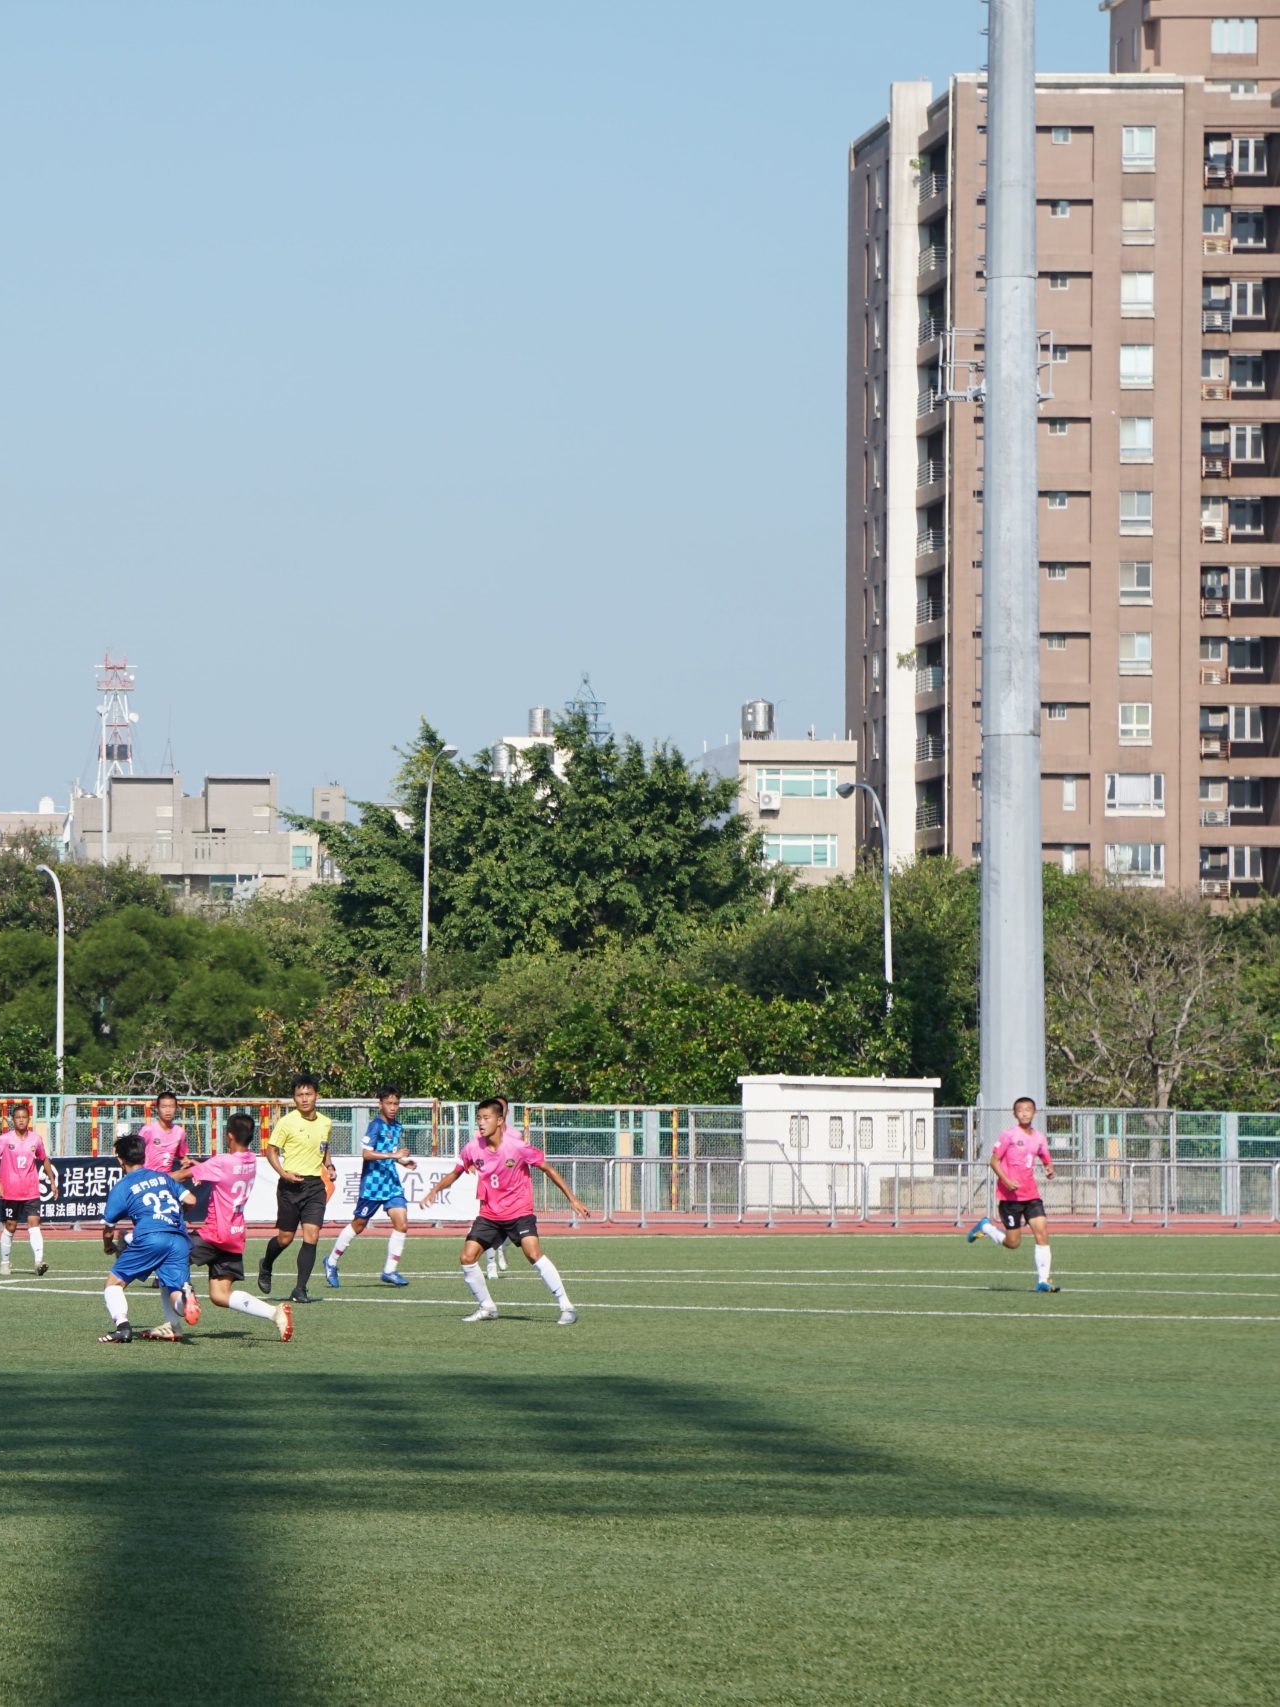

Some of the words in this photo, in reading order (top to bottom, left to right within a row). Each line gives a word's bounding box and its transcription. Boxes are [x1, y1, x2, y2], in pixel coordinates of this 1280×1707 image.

[17, 1156, 27, 1169] 12
[1026, 1154, 1033, 1168] 3
[490, 1174, 500, 1189] 8
[143, 1190, 180, 1214] 23
[5, 1208, 13, 1218] 12
[361, 1207, 369, 1216] 9
[1008, 1215, 1015, 1227] 3
